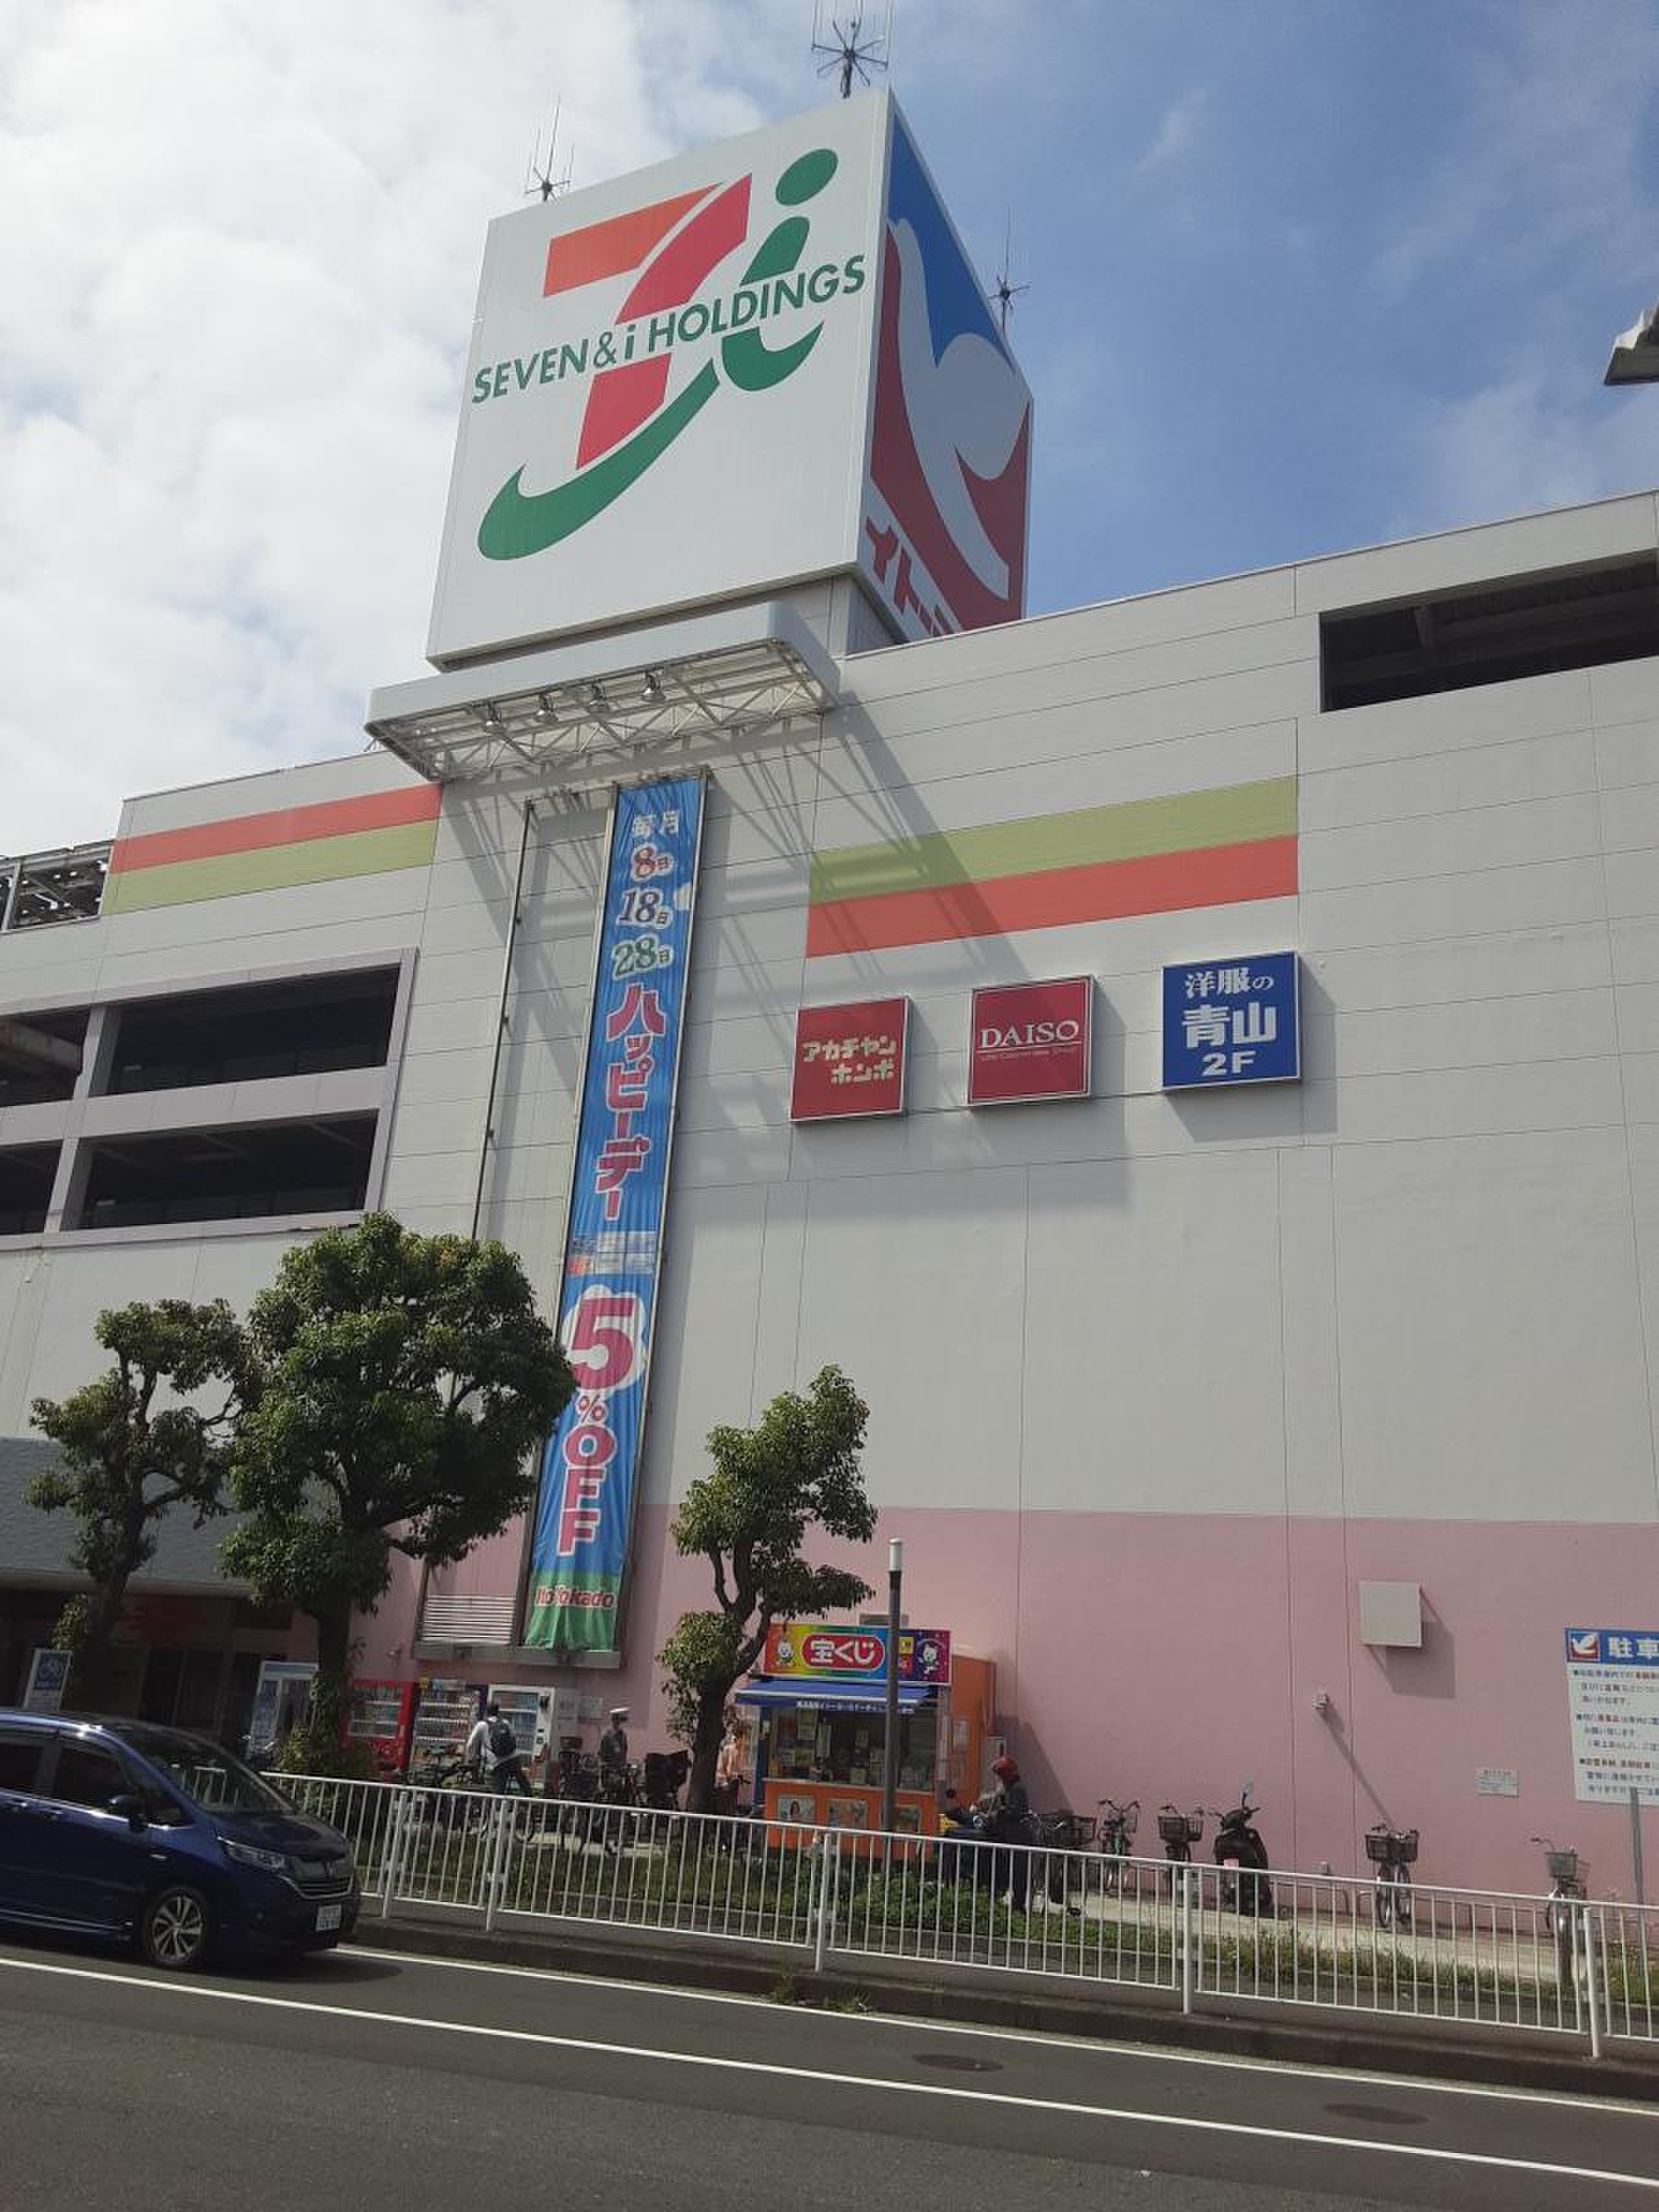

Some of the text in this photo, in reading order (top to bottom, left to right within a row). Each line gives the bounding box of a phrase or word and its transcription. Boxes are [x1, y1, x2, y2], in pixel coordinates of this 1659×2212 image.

[647, 254, 865, 354] HOLDINGS
[618, 888, 671, 927] 18日
[613, 935, 672, 979] 28日
[1184, 967, 1275, 998] 洋服の
[980, 1020, 1080, 1049] DAISO
[1182, 1002, 1277, 1047] 青山
[1202, 1050, 1256, 1077] 2F
[596, 984, 665, 1218] ハッピーデー
[810, 1638, 875, 1664] 宝くじ
[1608, 1637, 1659, 1659] 駐車
